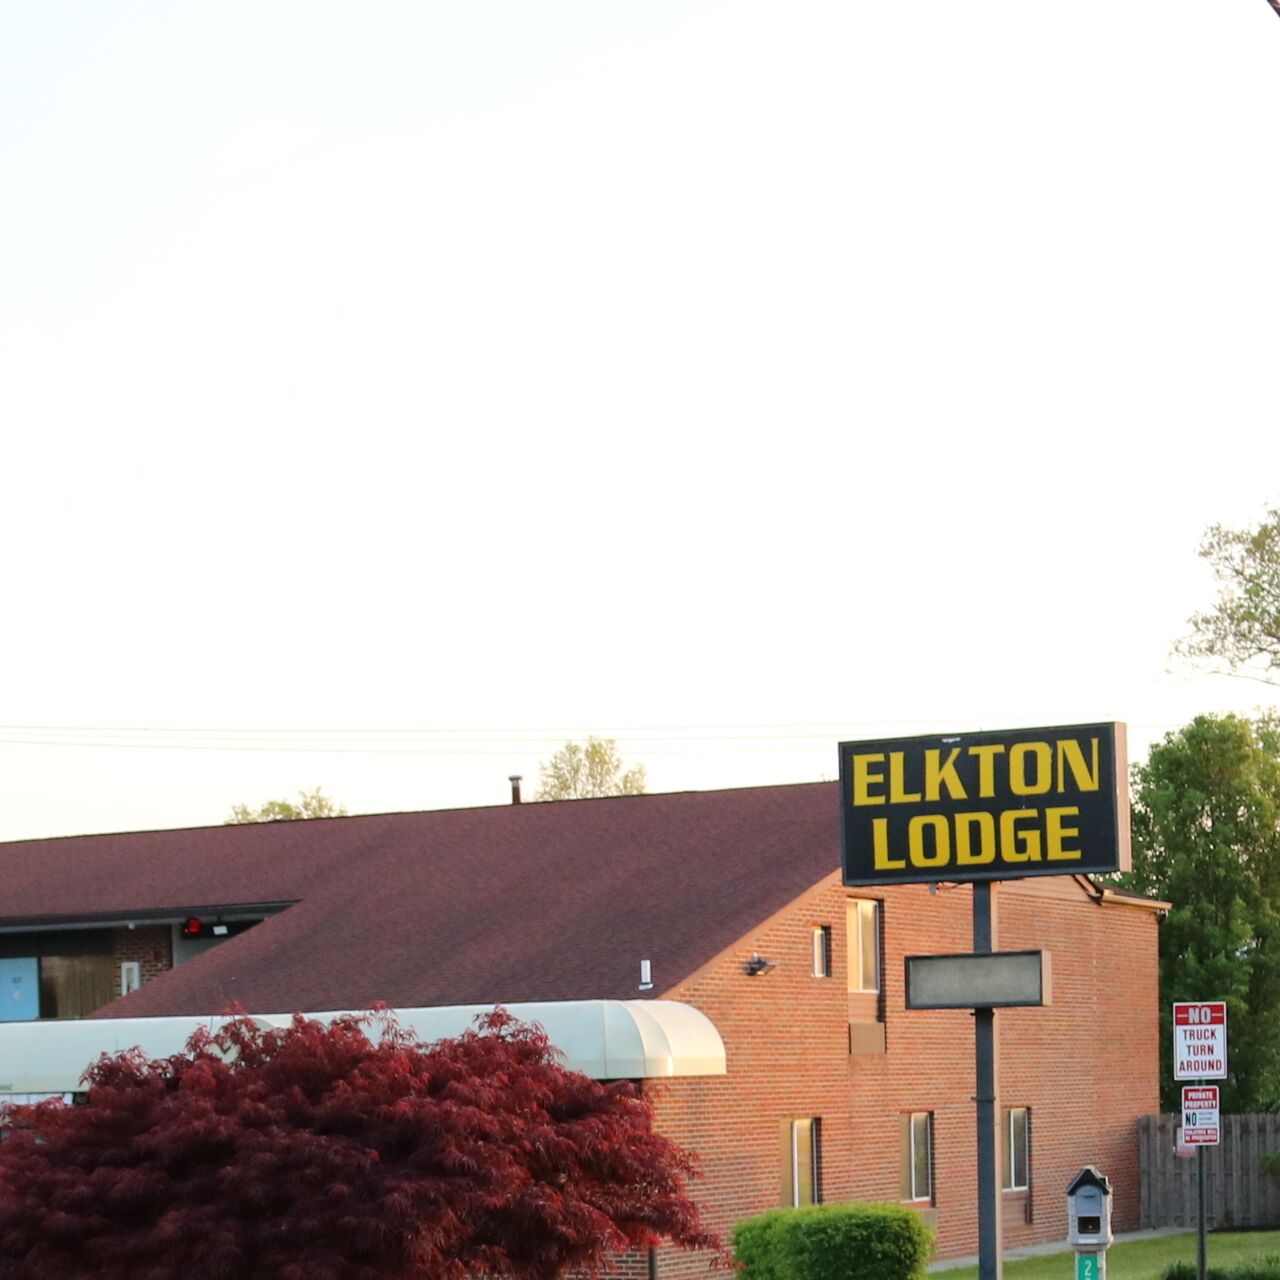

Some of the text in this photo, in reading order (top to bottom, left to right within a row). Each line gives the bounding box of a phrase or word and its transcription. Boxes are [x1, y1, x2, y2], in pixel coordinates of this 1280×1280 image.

[852, 737, 1100, 807] ELKTON
[872, 806, 1082, 871] LODGE
[1188, 1007, 1211, 1024] NO
[1182, 1028, 1217, 1040] TRUCK
[1186, 1044, 1214, 1056] TURN
[1179, 1059, 1222, 1072] AROUND
[1185, 1112, 1197, 1126] NO
